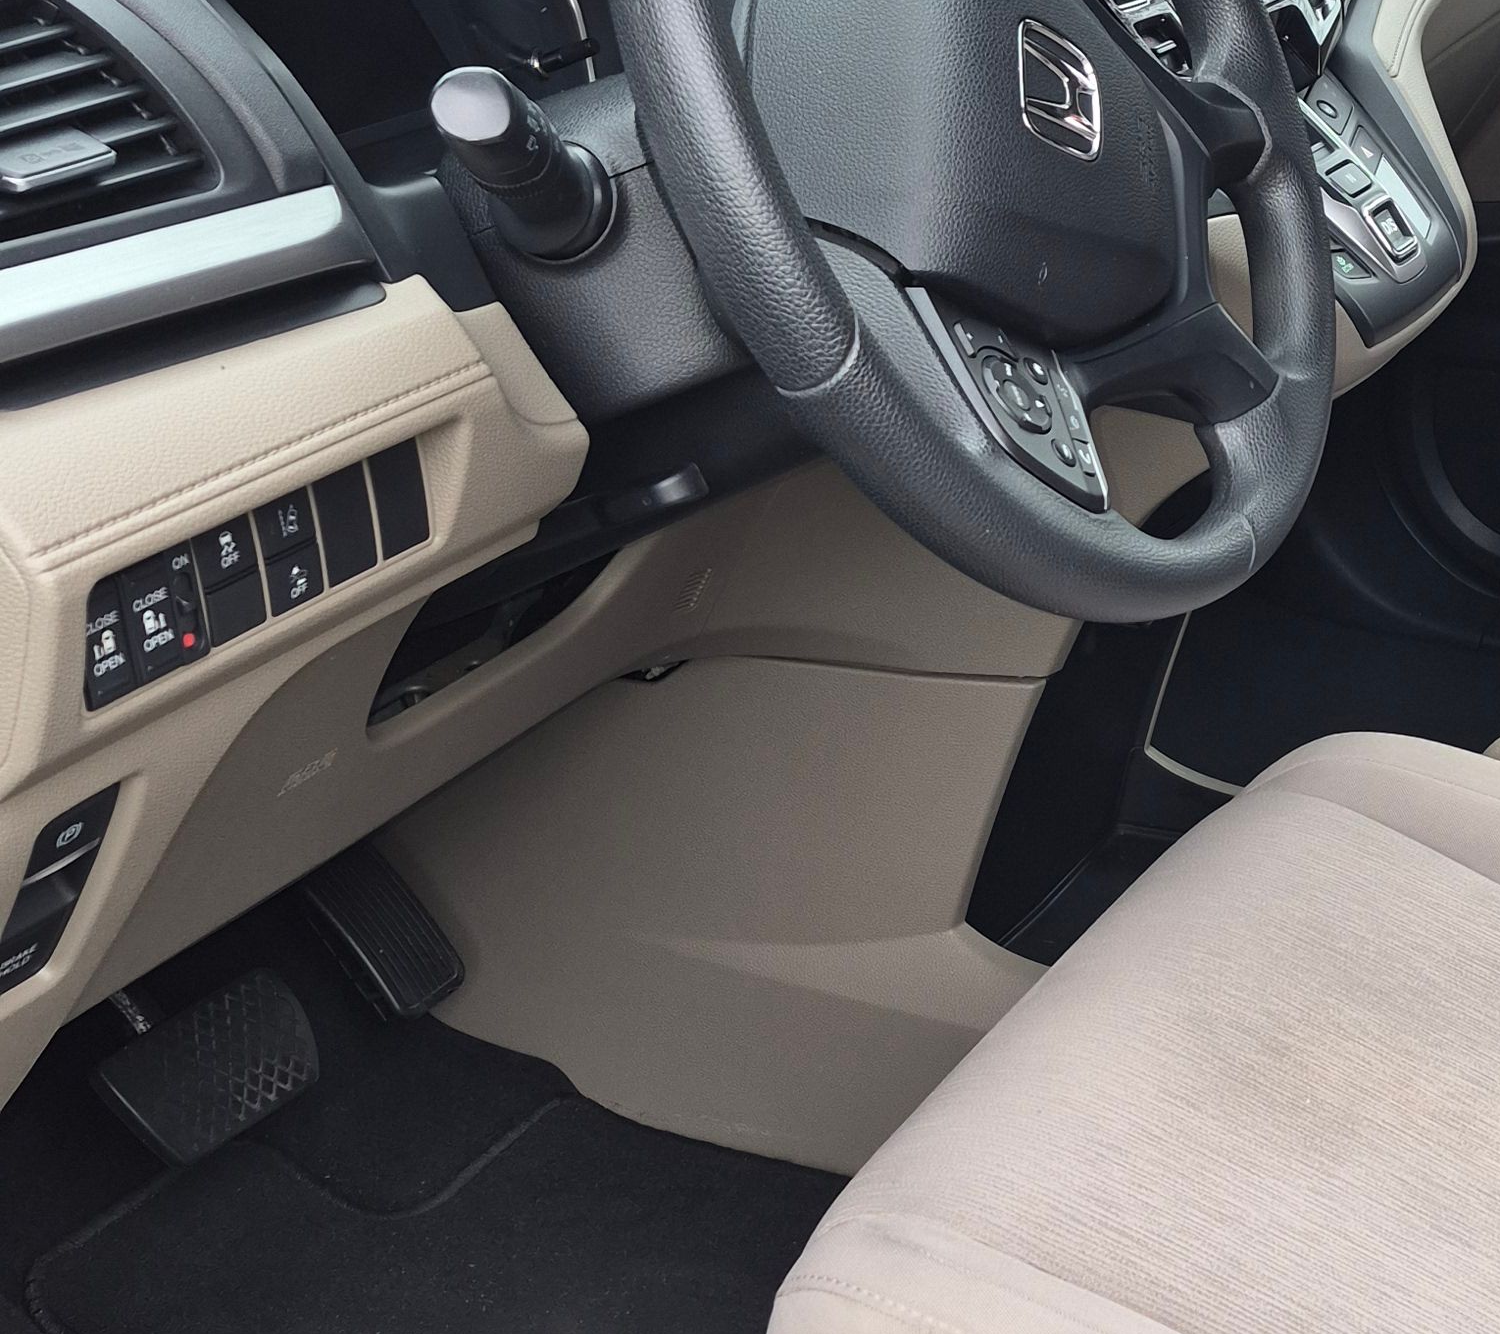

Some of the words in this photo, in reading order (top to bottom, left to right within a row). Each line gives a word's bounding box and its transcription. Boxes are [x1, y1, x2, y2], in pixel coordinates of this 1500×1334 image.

[171, 553, 190, 570] ON
[220, 551, 240, 569] OFF
[132, 586, 169, 613] CLOSE
[290, 582, 308, 599] OFF
[143, 628, 175, 653] OPEN
[93, 651, 126, 677] OPEN
